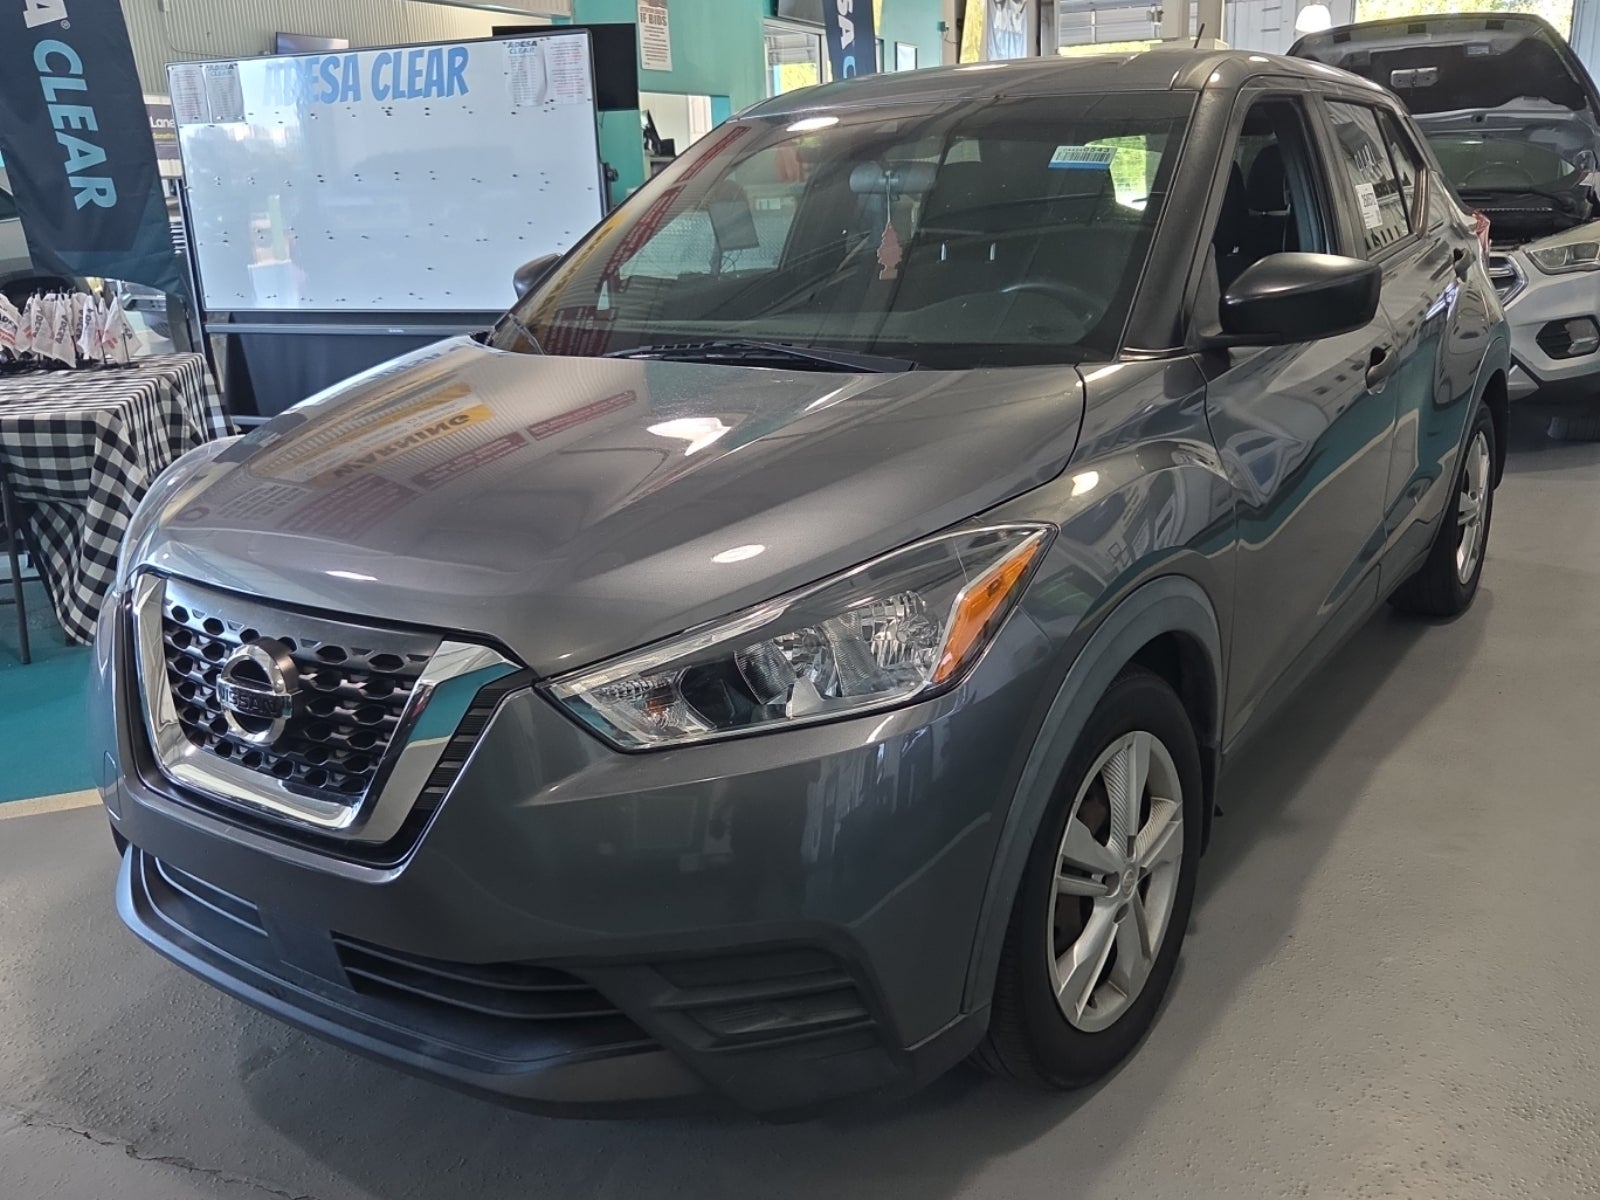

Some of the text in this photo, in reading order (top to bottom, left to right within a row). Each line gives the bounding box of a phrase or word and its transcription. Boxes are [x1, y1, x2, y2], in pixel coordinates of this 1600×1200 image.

[371, 46, 470, 101] CLEAR
[33, 39, 118, 211] CLEAR
[149, 116, 176, 128] Lane
